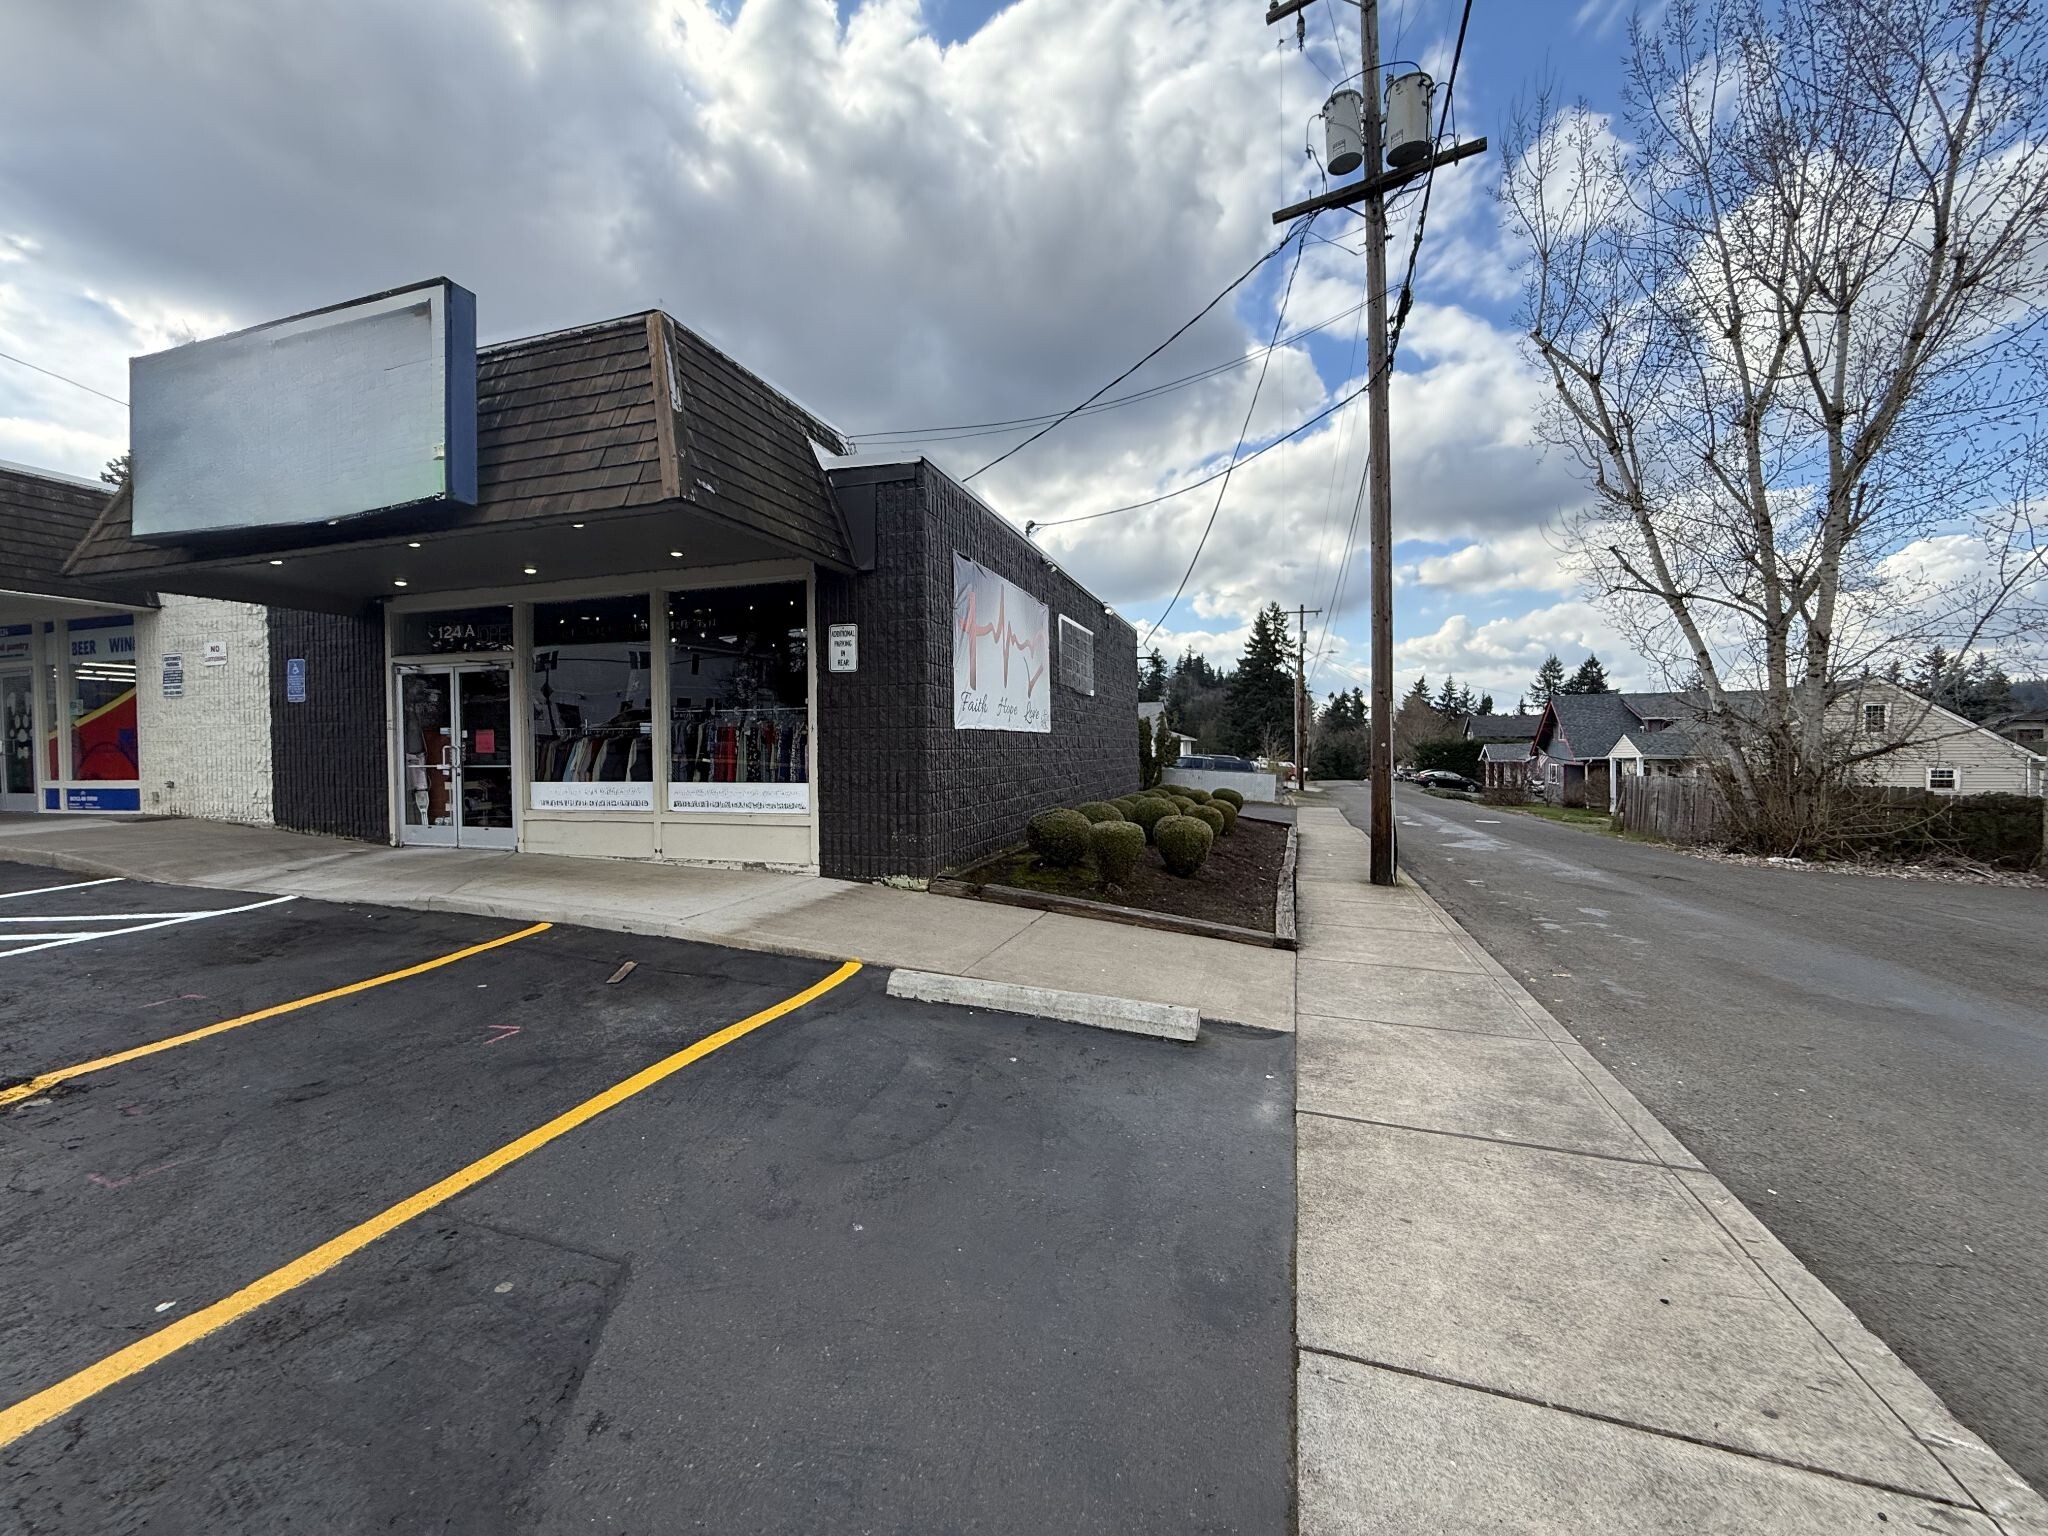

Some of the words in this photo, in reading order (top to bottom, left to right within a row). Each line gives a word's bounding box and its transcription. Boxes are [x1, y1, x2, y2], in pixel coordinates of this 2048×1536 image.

[438, 625, 461, 639] 124
[465, 624, 476, 637] A
[72, 640, 97, 656] BEER
[960, 691, 988, 713] Faith
[996, 696, 1018, 722] Hope
[1024, 701, 1040, 724] Love
